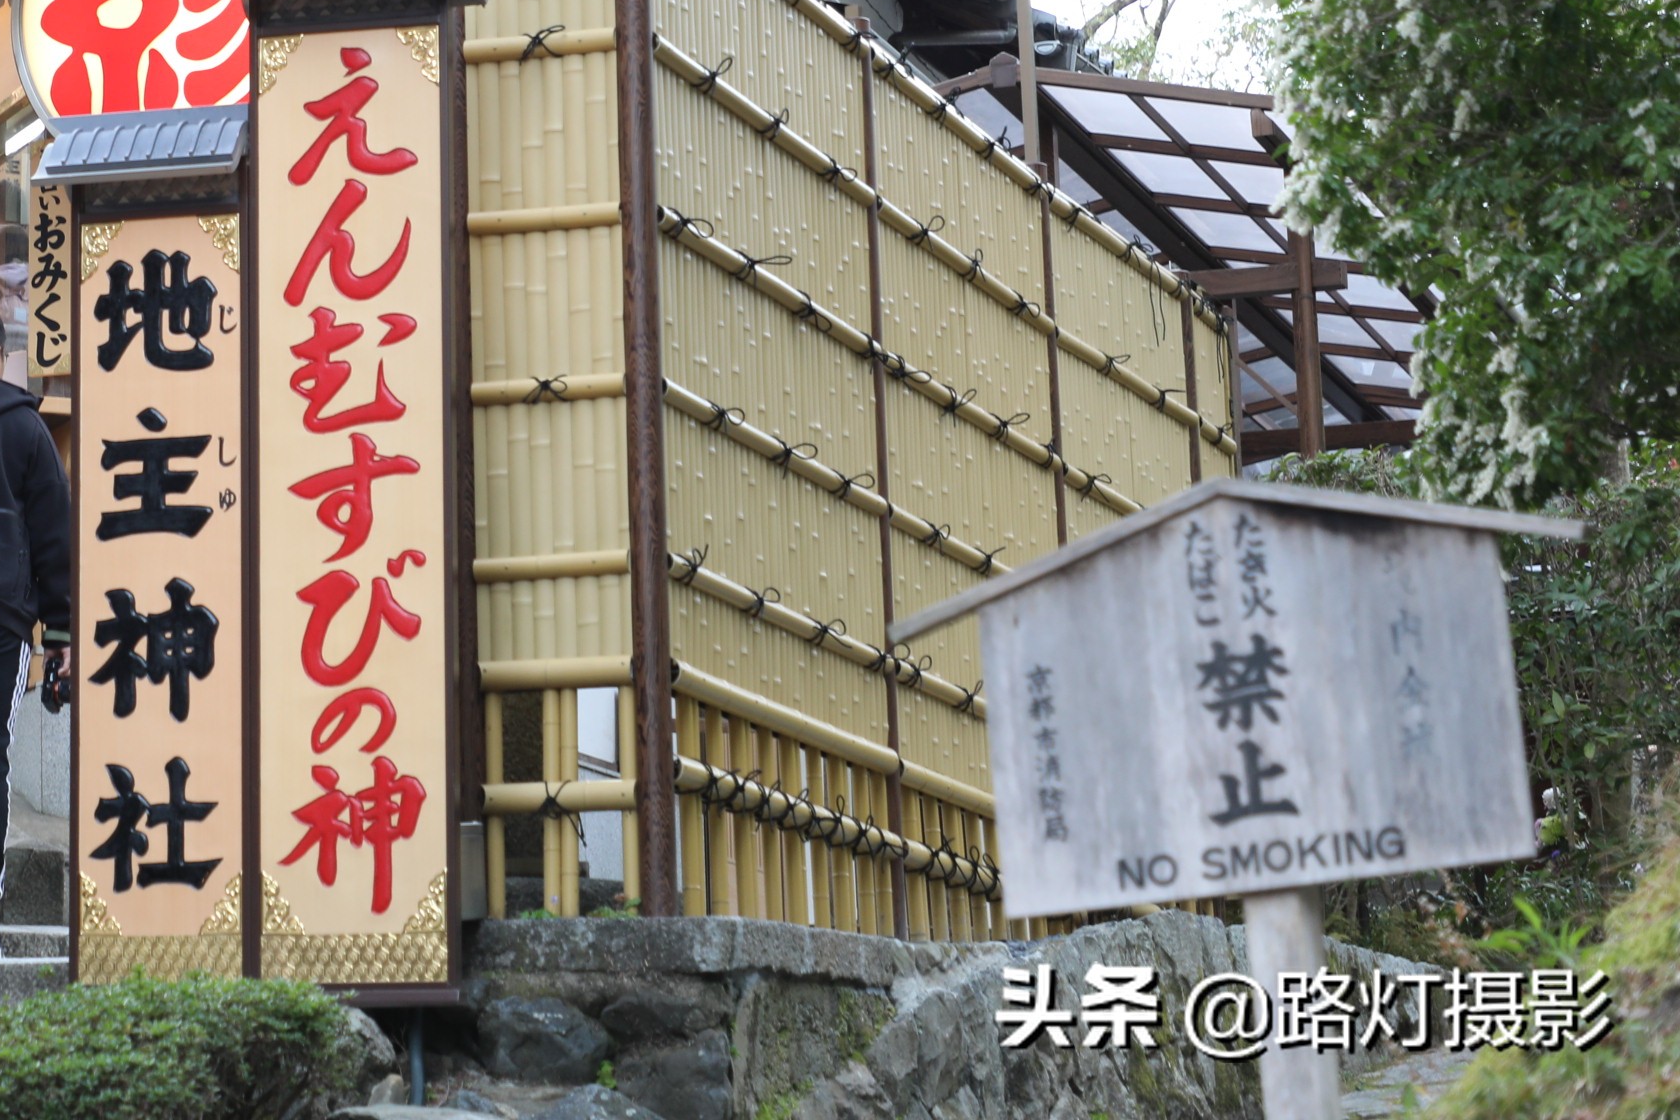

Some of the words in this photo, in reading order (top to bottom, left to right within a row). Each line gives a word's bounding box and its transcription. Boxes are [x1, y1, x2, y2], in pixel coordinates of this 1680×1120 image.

[218, 304, 238, 334] じ
[280, 46, 426, 915] えんむすびの神
[89, 247, 224, 894] 地主神社
[1184, 520, 1222, 628] たばこ
[1233, 513, 1278, 621] たき火
[1195, 633, 1301, 828] 禁止
[1116, 854, 1178, 892] NO
[1201, 826, 1407, 881] SMOKING
